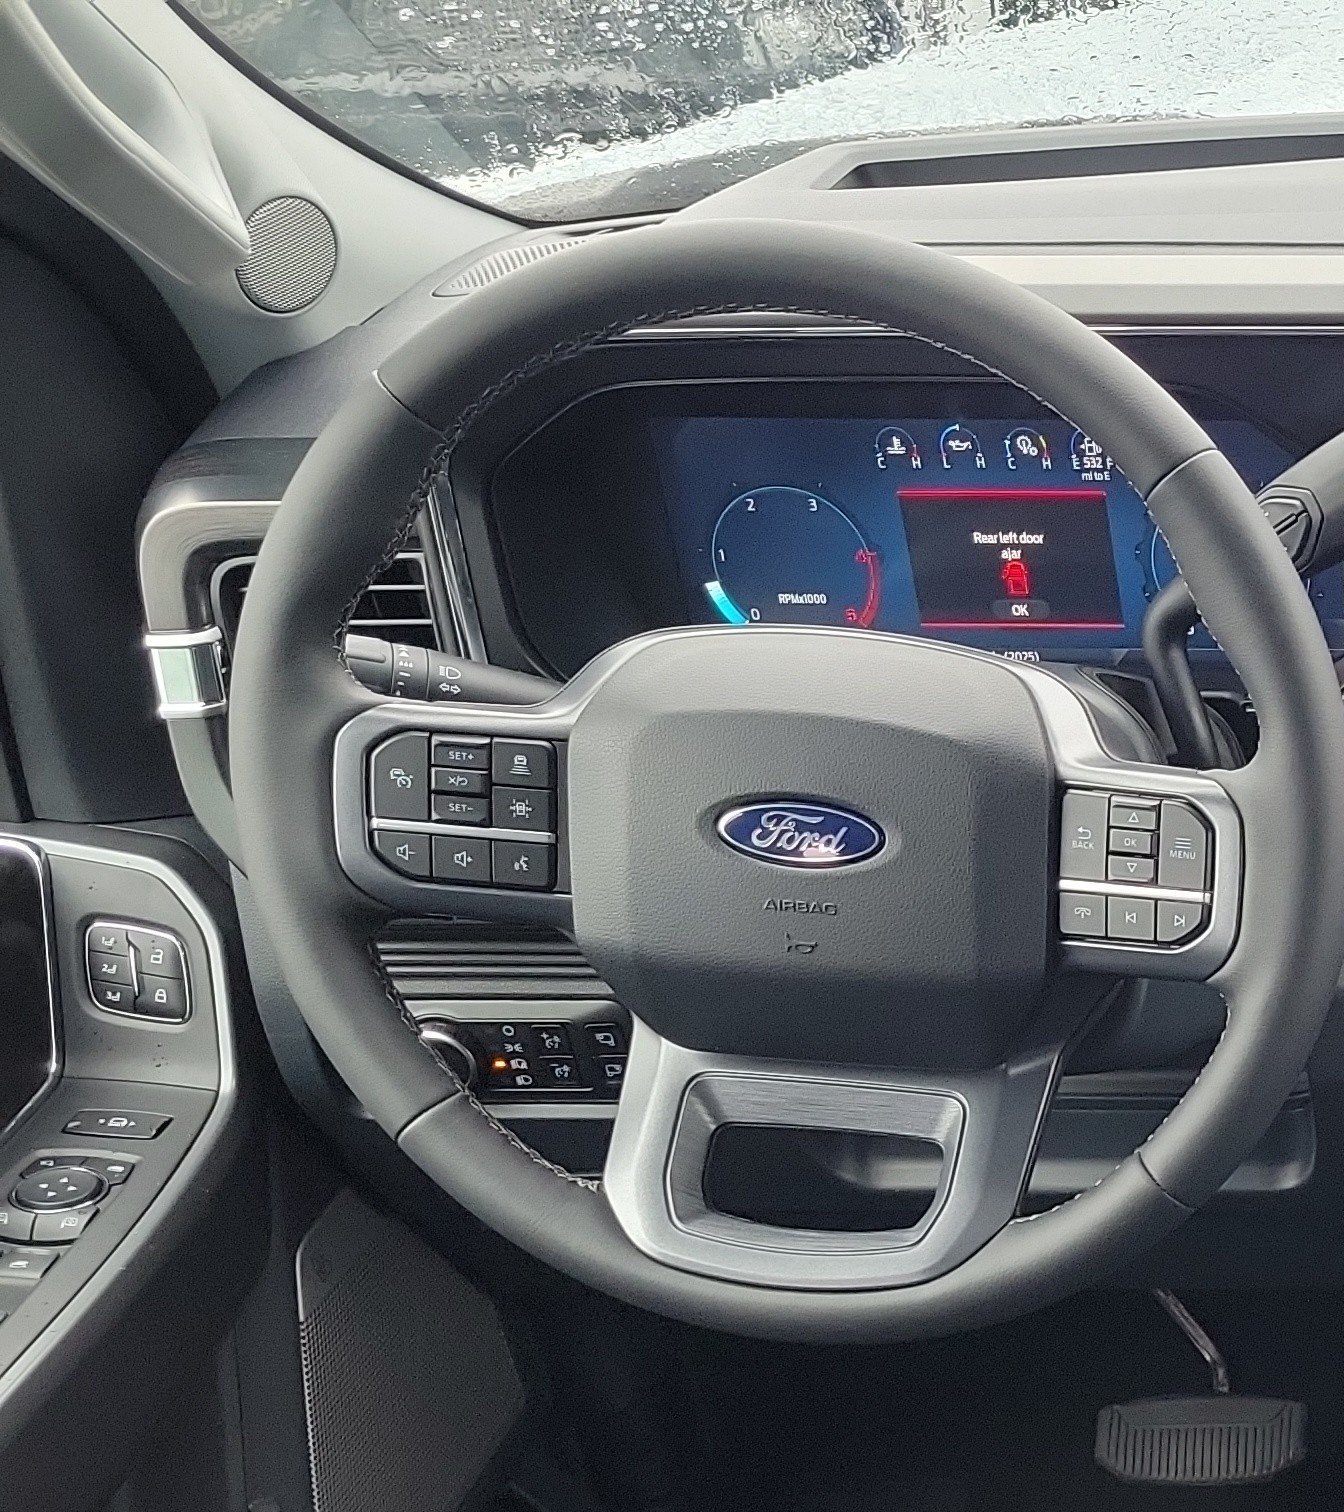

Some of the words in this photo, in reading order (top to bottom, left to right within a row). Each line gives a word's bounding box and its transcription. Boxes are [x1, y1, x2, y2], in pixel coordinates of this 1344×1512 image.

[877, 457, 887, 469] C
[912, 457, 922, 469] H
[943, 457, 951, 469] L
[976, 458, 986, 469] H
[1008, 458, 1017, 470] C
[1042, 457, 1052, 470] H
[1073, 457, 1080, 470] E
[1083, 456, 1104, 469] 532
[1104, 471, 1111, 481] E
[746, 499, 756, 512] 2
[808, 499, 818, 512] 3
[973, 532, 998, 545] Rear
[999, 531, 1019, 545] left
[1019, 531, 1045, 545] door
[718, 549, 726, 562] 1
[1001, 548, 1022, 562] ajar
[777, 593, 828, 605] RPMx1000
[750, 607, 761, 621] 0
[1011, 604, 1030, 617] OK
[448, 751, 475, 761] SET+
[448, 802, 474, 812] SET-
[751, 810, 849, 854] Ford
[1072, 840, 1095, 850] BACK
[1123, 837, 1137, 847] OK
[1169, 850, 1196, 860] MENU
[763, 898, 838, 916] AIRBAG
